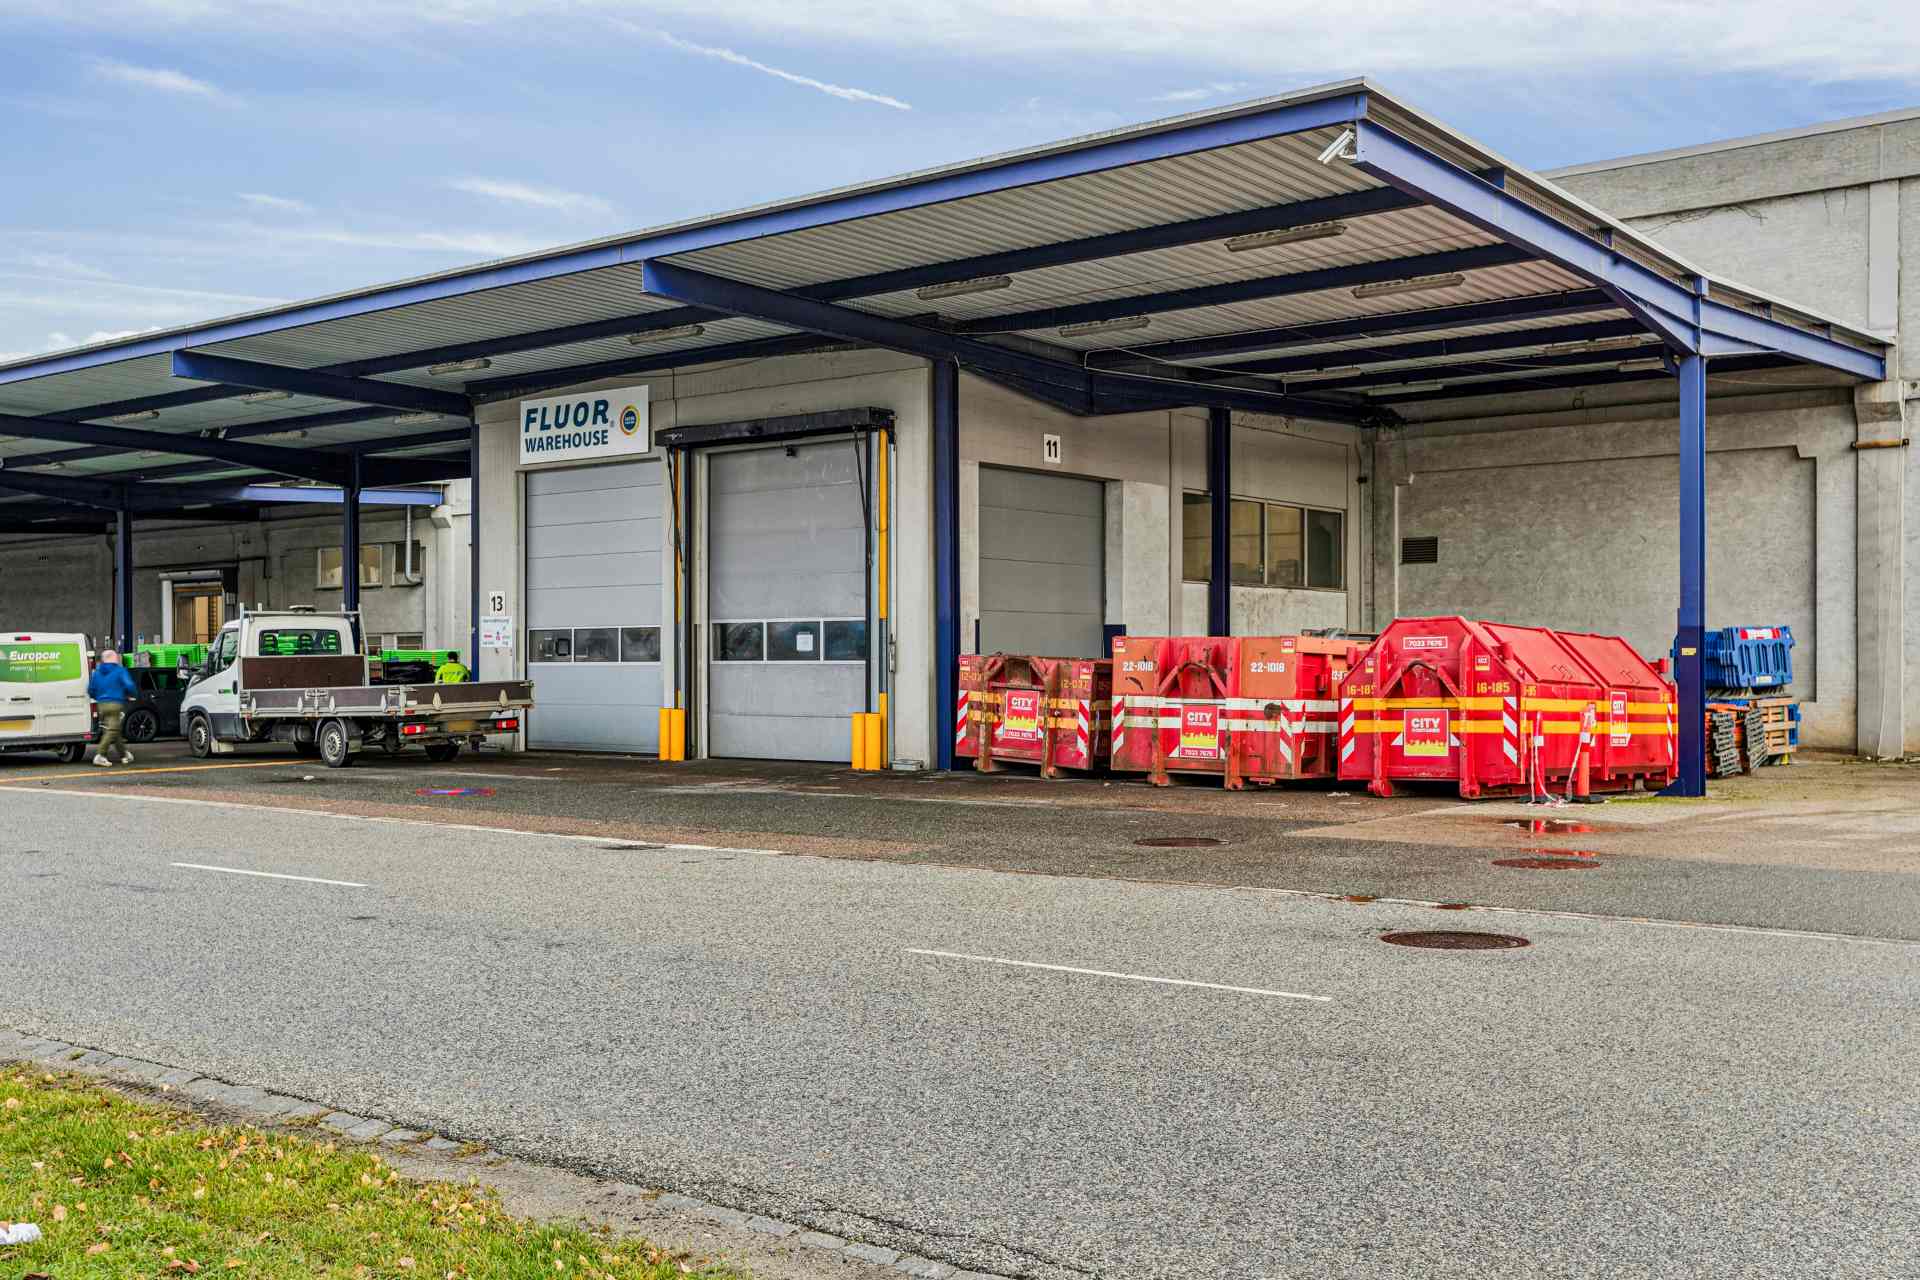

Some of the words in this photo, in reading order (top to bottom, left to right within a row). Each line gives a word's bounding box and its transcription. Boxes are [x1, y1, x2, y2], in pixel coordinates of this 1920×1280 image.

[525, 400, 609, 432] FLUOR
[525, 430, 609, 452] WAREHOUSE
[1046, 440, 1058, 458] 11
[491, 595, 503, 611] 13
[9, 650, 61, 663] Europcar
[1476, 682, 1510, 693] 16-185
[1011, 697, 1033, 707] CITY
[1187, 712, 1212, 721] CITY
[1411, 717, 1440, 728] CITY
